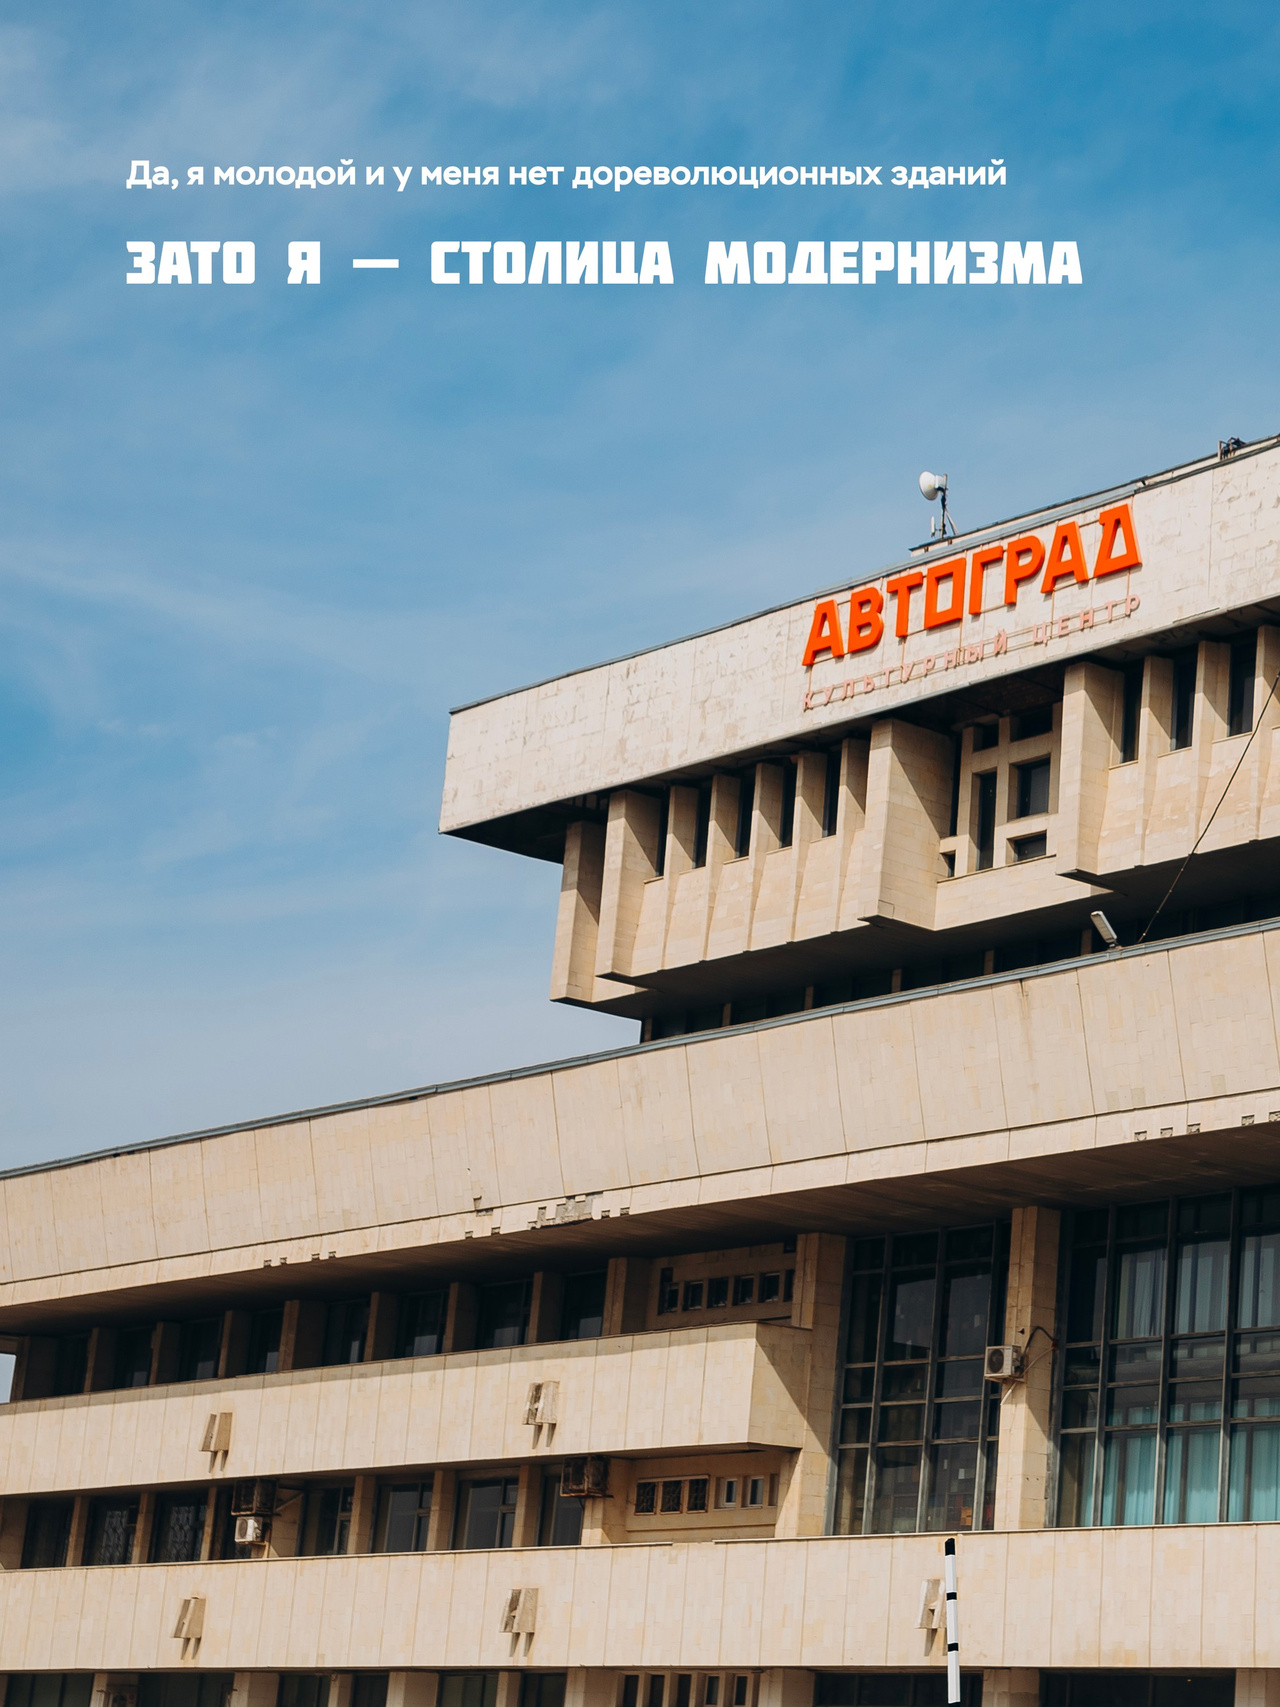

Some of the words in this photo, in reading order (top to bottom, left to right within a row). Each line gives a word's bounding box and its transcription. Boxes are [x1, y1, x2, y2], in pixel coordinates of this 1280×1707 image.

[802, 503, 1142, 667] АВТОГРАД
[802, 628, 1008, 711] КУЛЬТУРНЫЙ
[1032, 593, 1141, 645] ЦЕНТР
